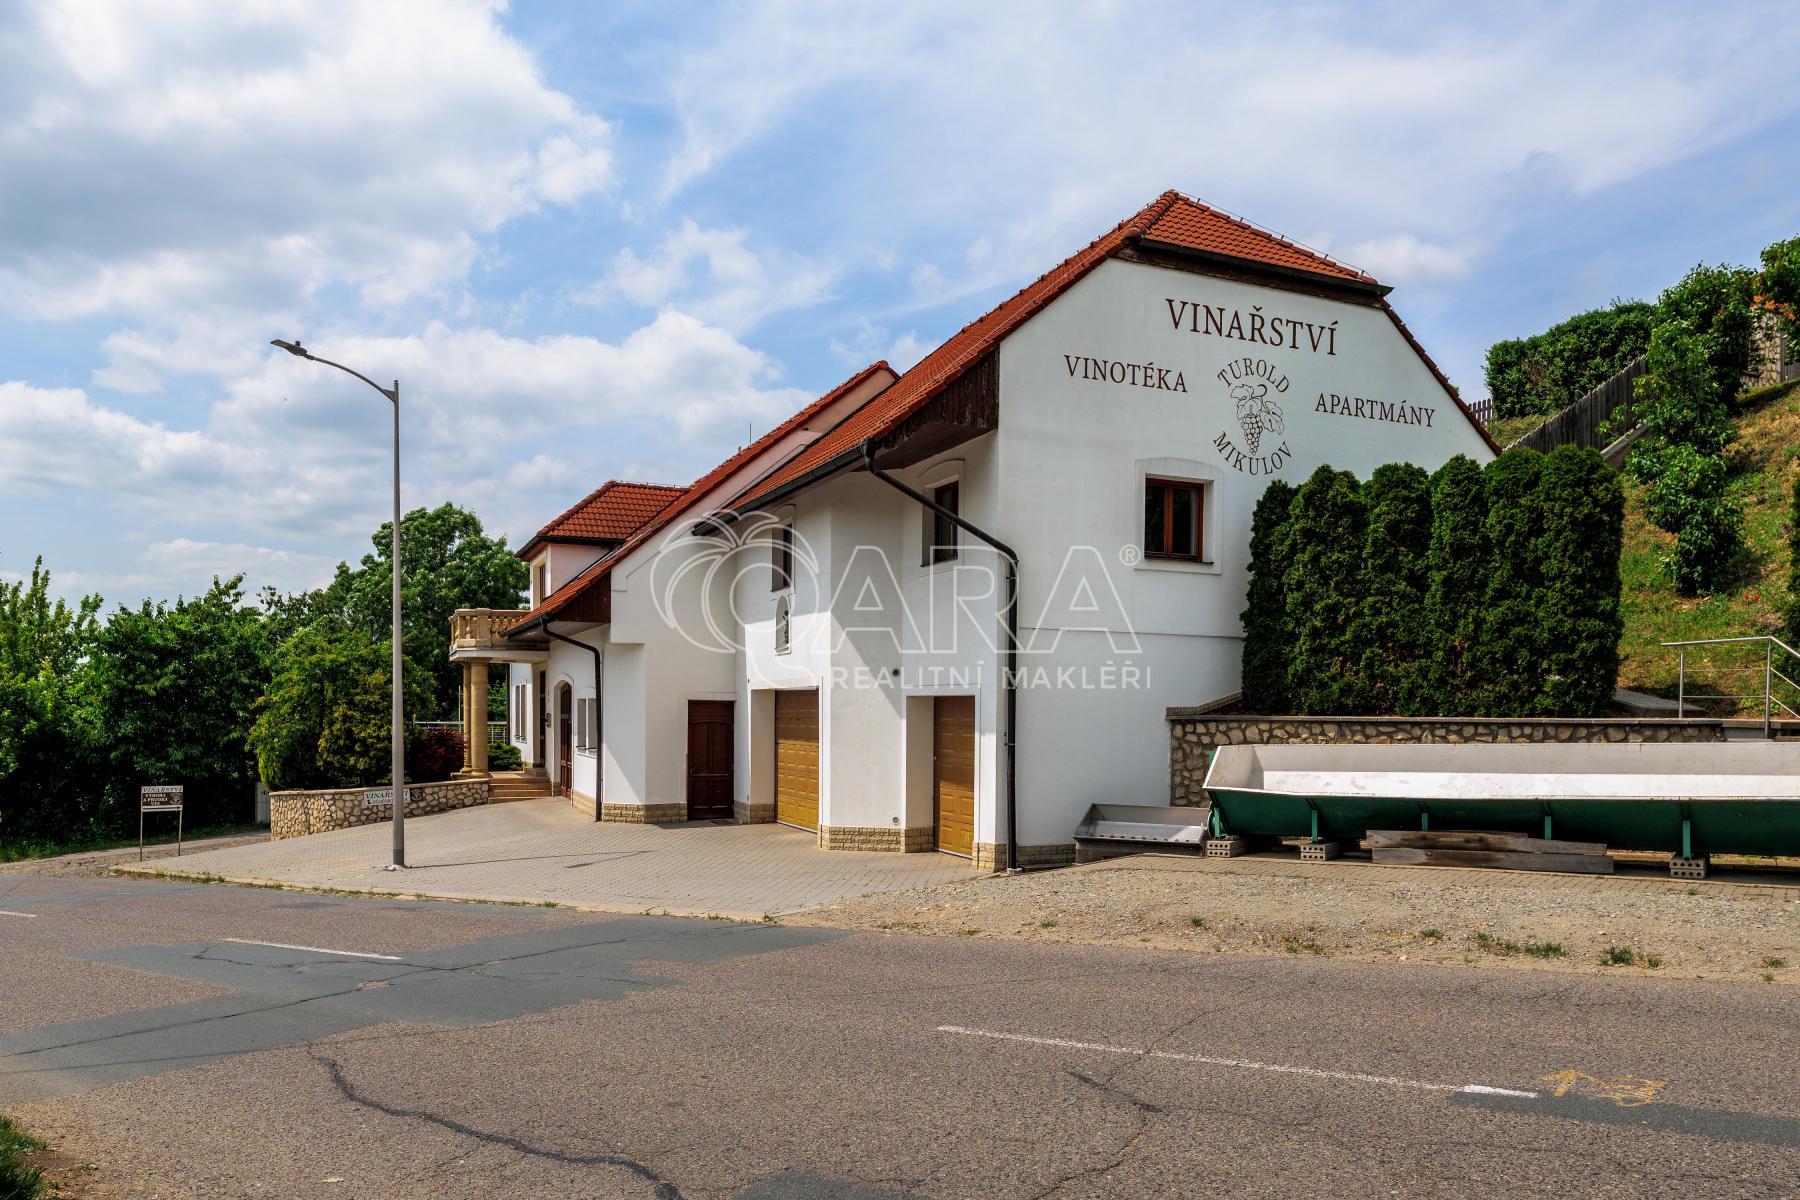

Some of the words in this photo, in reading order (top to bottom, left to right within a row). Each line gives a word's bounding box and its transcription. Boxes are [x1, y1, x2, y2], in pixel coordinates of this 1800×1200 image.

[1165, 298, 1338, 356] VINAŘSTVÍ
[1063, 354, 1189, 394] VINOTÉKA
[1217, 357, 1290, 393] TUROLD
[1314, 392, 1436, 428] APARTMÁNY
[1213, 430, 1292, 476] MIKULOV
